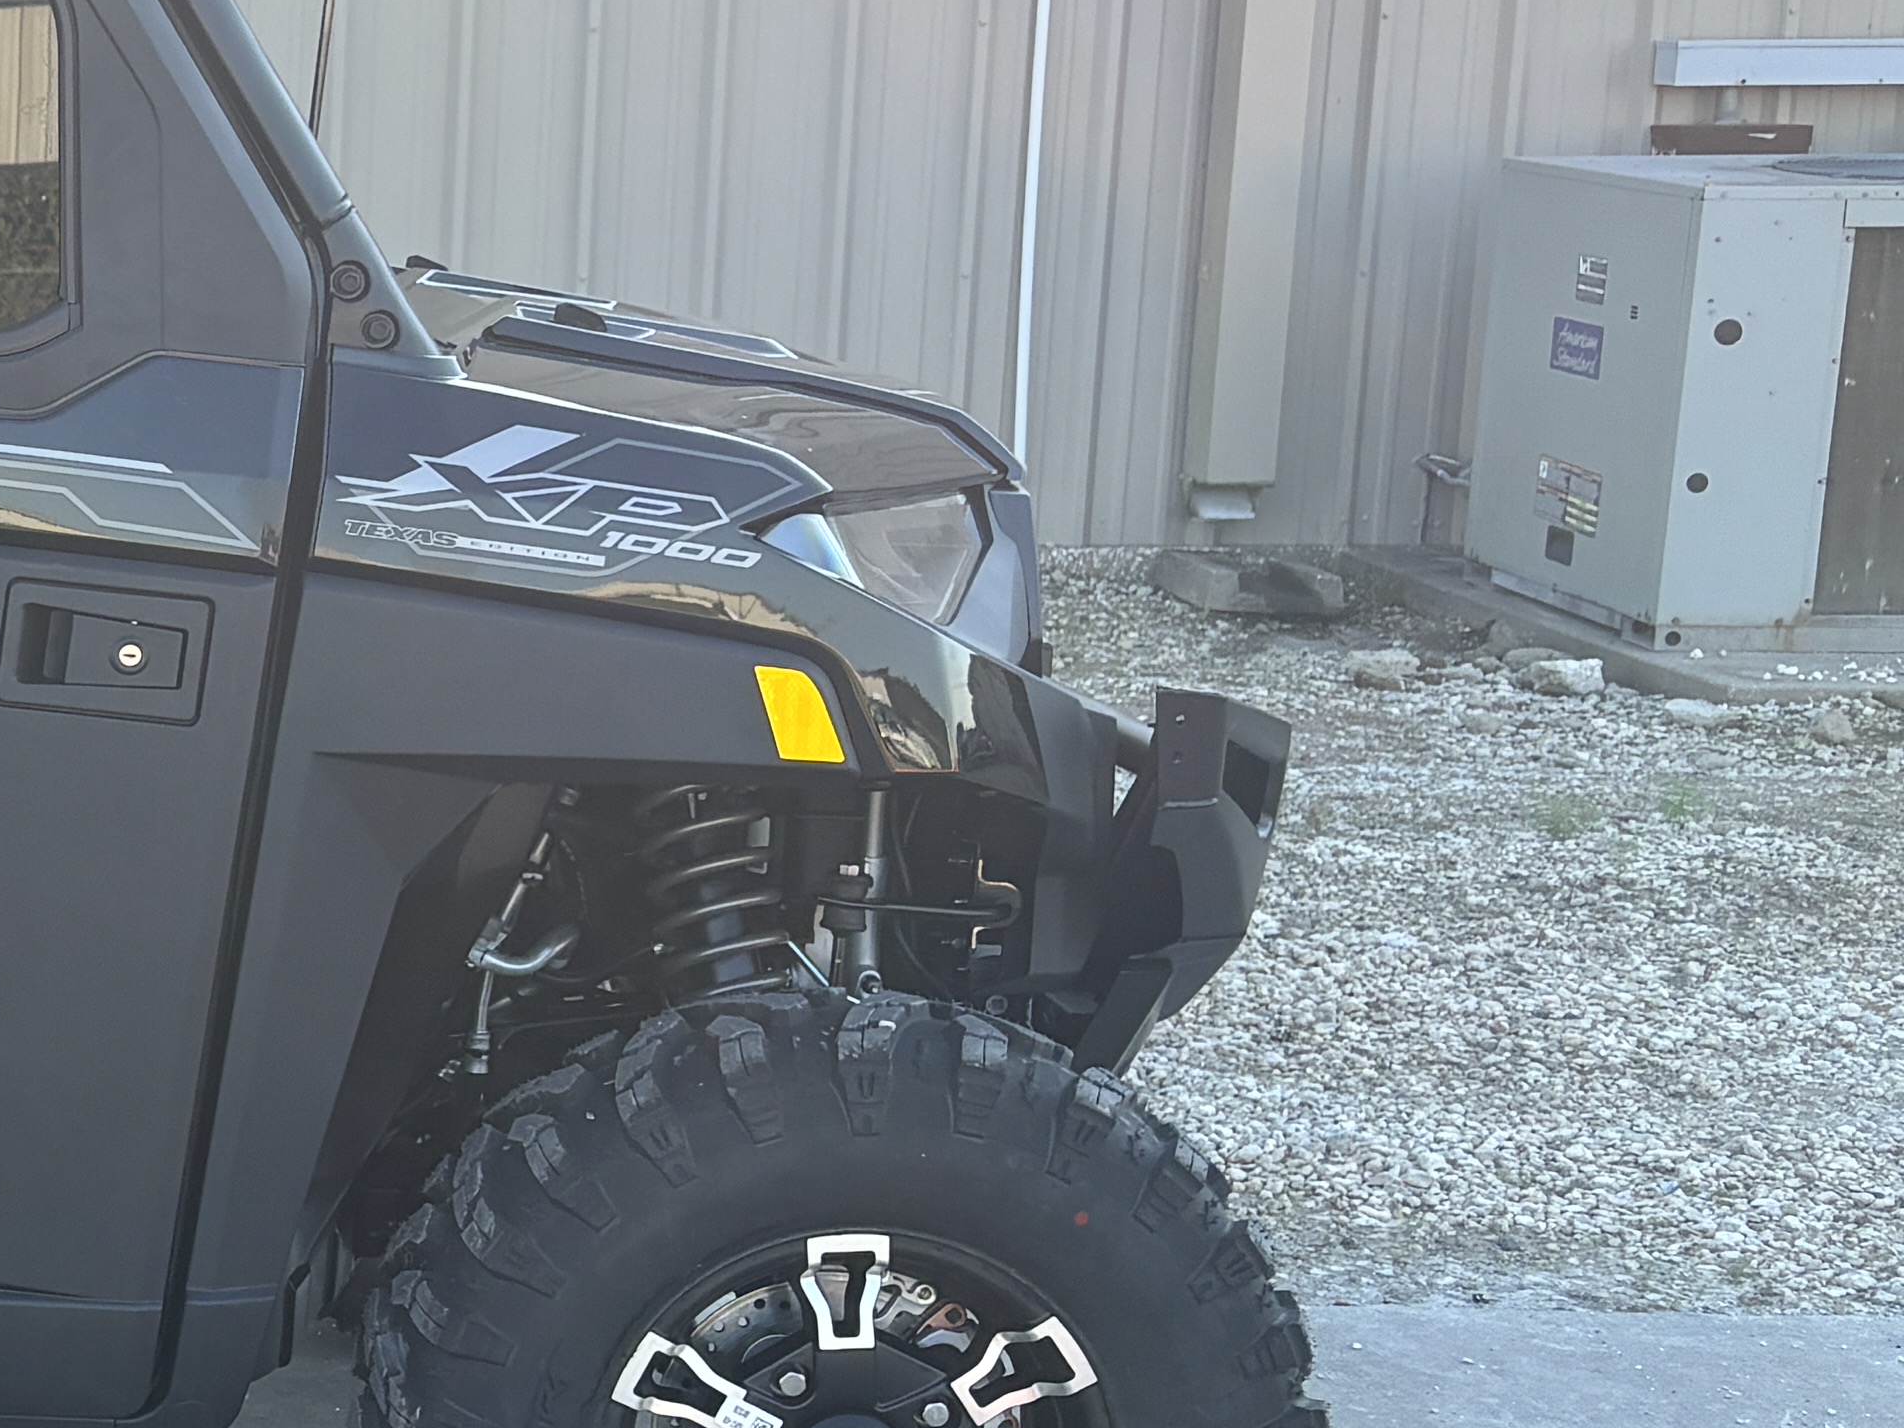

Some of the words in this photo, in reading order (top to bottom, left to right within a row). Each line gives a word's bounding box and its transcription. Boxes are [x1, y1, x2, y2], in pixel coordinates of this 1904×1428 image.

[335, 425, 731, 536] XP
[343, 519, 461, 548] TEXAS
[469, 540, 592, 562] EDITION
[599, 530, 763, 569] 1000
